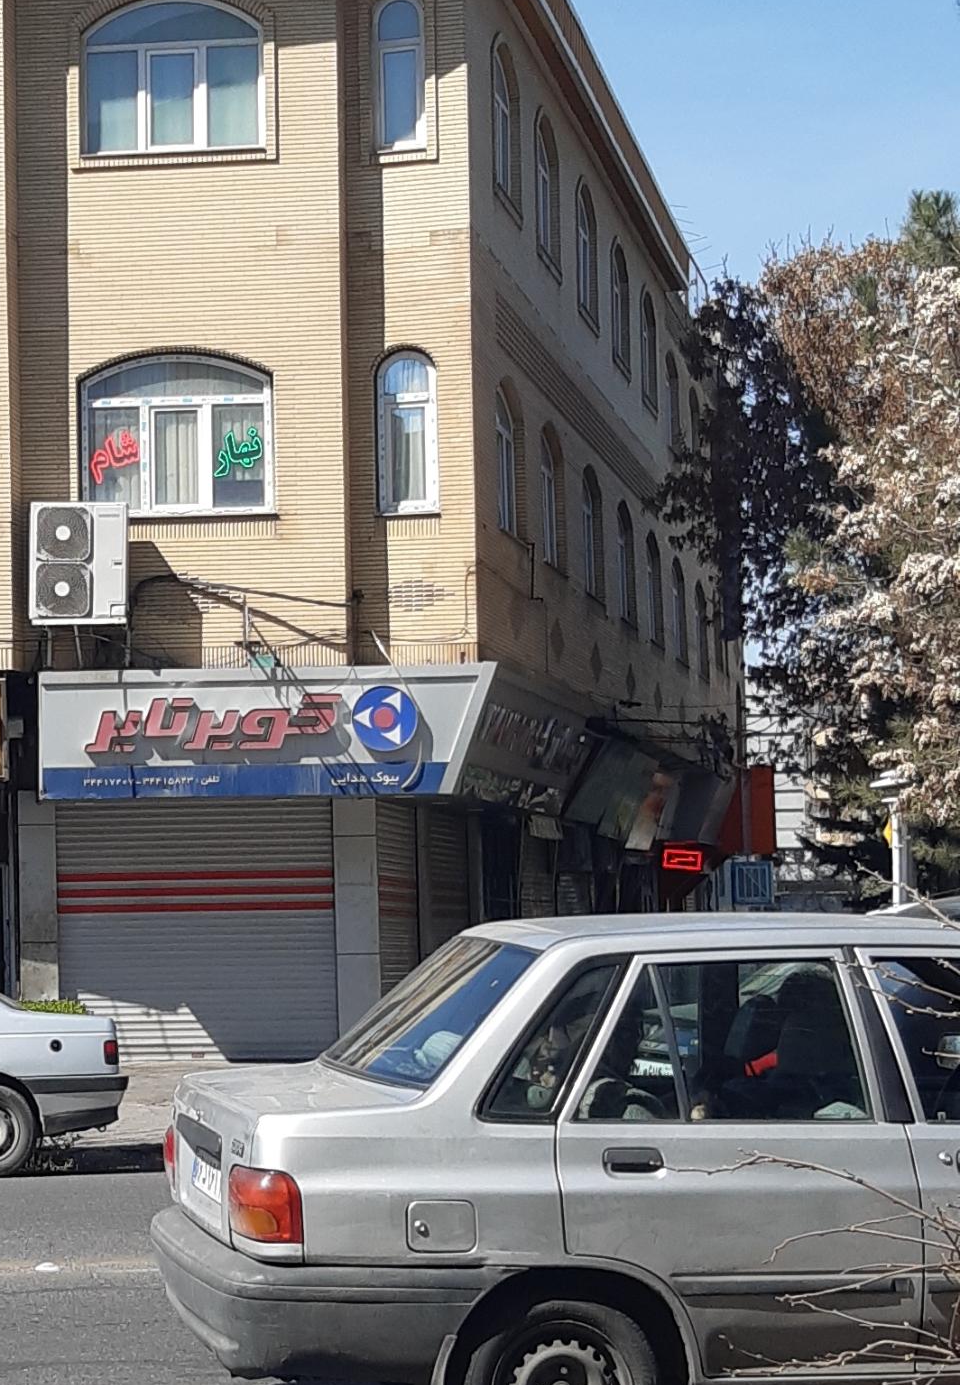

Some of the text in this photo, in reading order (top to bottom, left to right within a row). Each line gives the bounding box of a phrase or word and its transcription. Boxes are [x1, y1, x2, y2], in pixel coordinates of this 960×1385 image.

[90, 429, 140, 485] شام
[214, 426, 263, 478] نهار
[84, 693, 343, 753] کویر تایر
